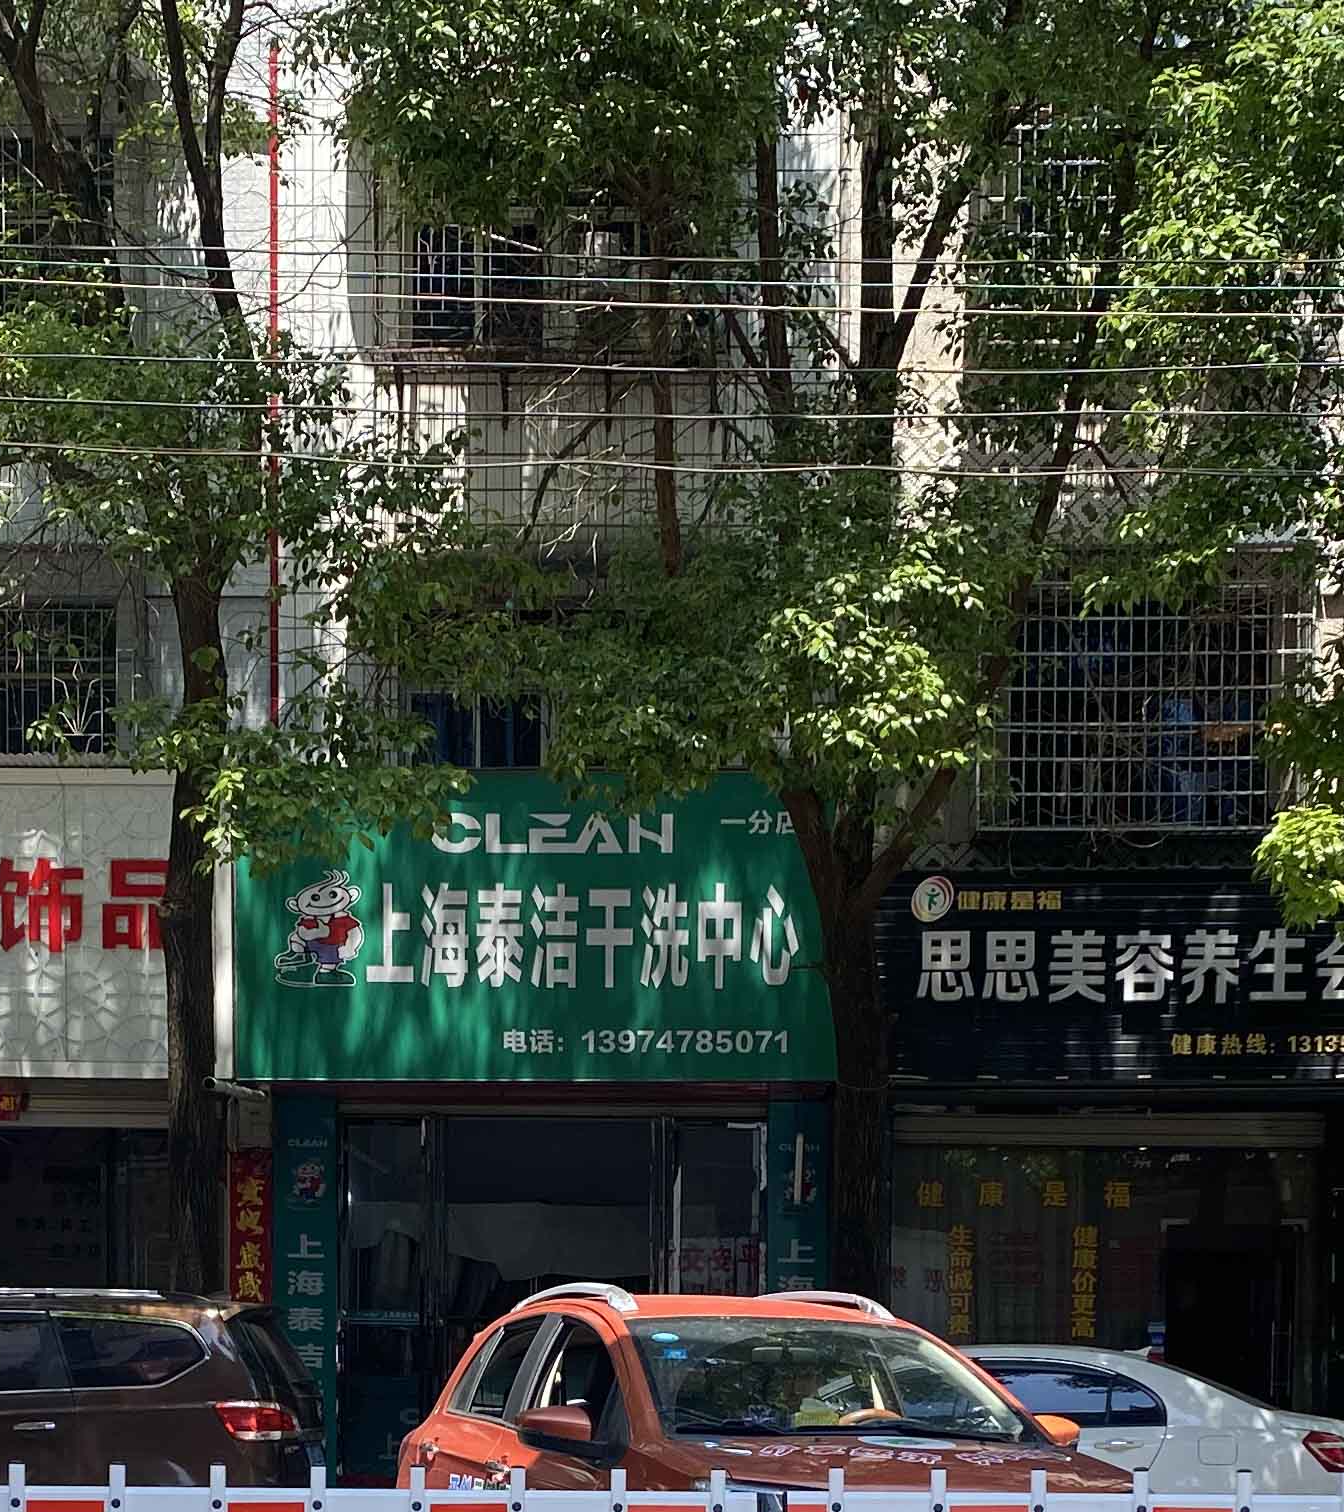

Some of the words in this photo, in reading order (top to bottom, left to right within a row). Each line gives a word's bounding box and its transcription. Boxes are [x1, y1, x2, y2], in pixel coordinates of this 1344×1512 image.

[431, 811, 674, 854] CLEAN
[957, 889, 1062, 911] 健康是福
[366, 882, 800, 990] 上海泰洁干洗中心
[917, 1179, 1132, 1209] 健康是福
[1071, 1225, 1099, 1338] 健康价更高
